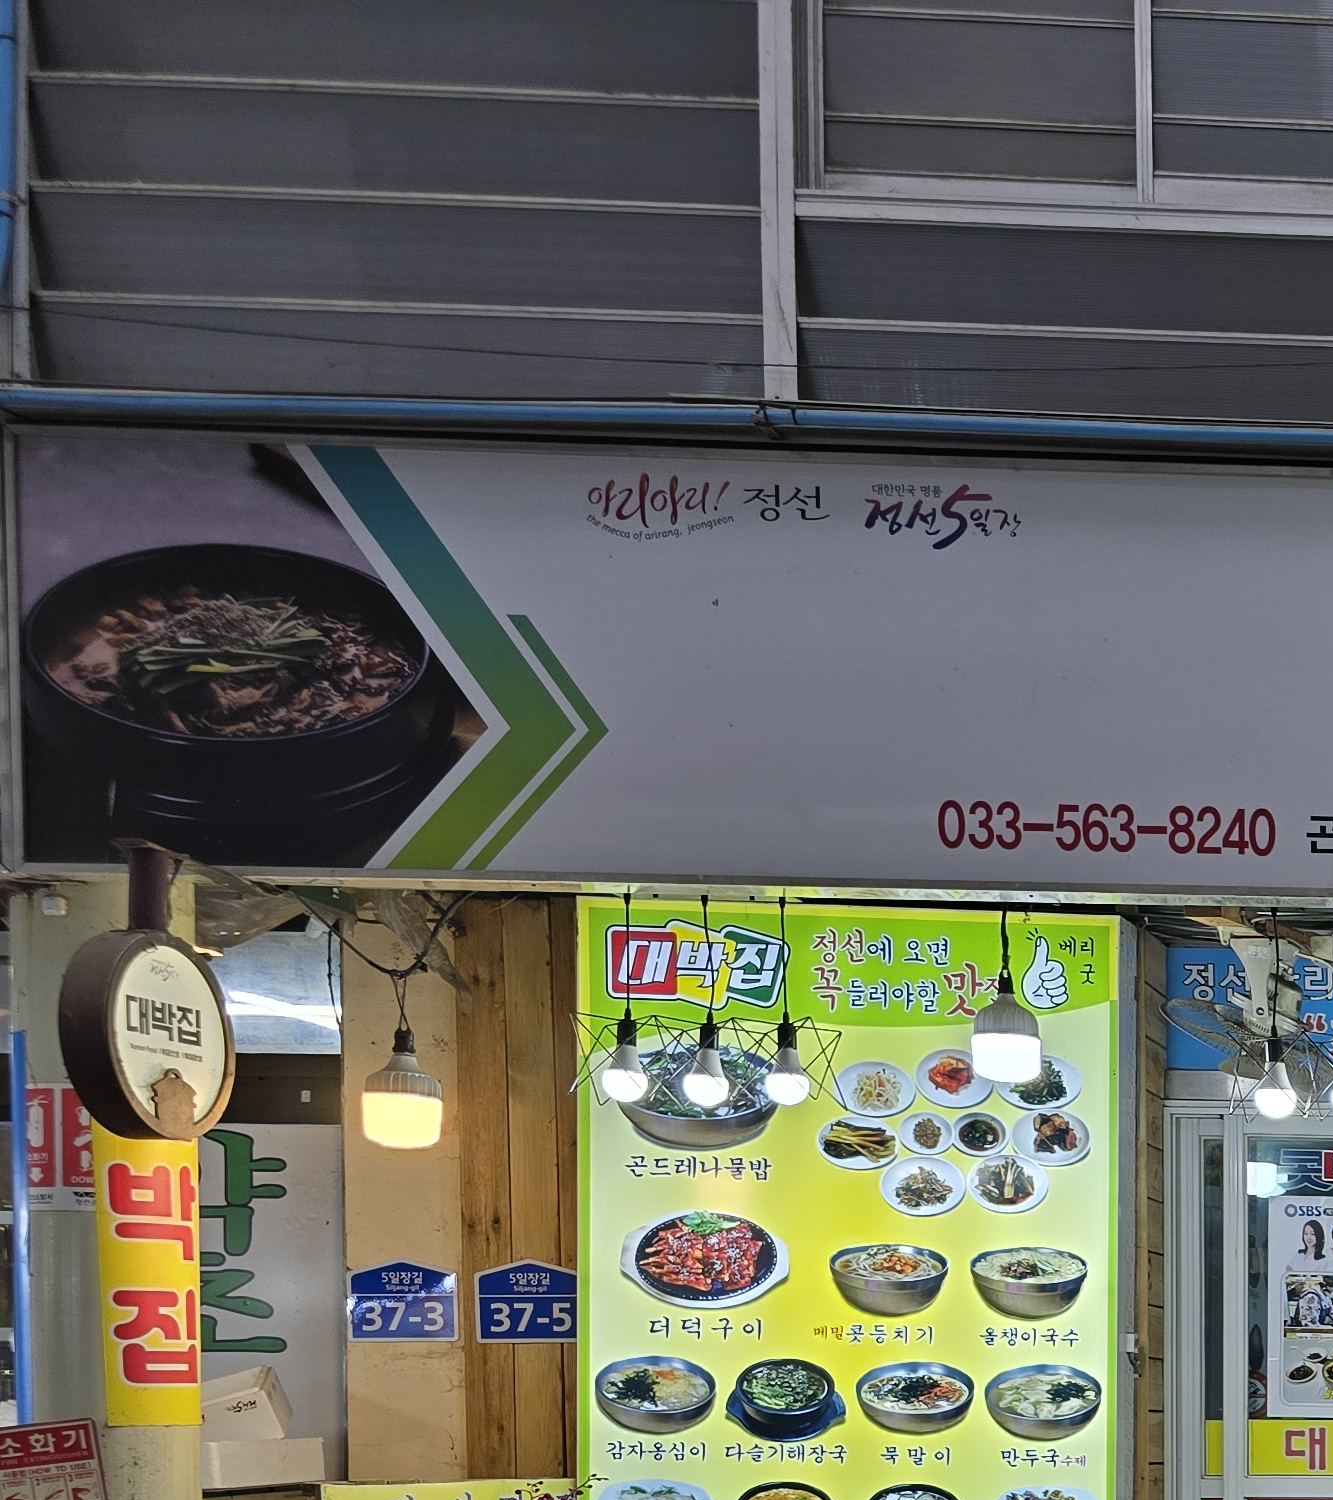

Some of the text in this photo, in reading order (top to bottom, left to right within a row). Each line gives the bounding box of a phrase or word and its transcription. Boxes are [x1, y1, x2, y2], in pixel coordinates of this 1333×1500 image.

[742, 484, 831, 523] 정선
[871, 484, 943, 498] 대한민국 명품
[585, 513, 601, 528] the
[601, 523, 631, 540] mecca
[633, 529, 644, 542] of
[687, 514, 735, 537] jeongseon
[937, 799, 1276, 857] 033-563-8240
[810, 927, 951, 966] 정선에 오면
[1058, 936, 1096, 958] 베리
[616, 934, 782, 991] 대박집
[125, 994, 203, 1048] 대박집
[624, 1155, 773, 1182] 곤드레나물밥
[1298, 1205, 1322, 1217] SBS
[108, 1162, 199, 1386] 박집
[381, 1271, 423, 1285] 5일장길
[509, 1272, 550, 1286] 5일장길
[361, 1301, 445, 1332] 37-3
[490, 1302, 572, 1332] 37-5
[648, 1316, 764, 1342] 더덕구이
[979, 1326, 1081, 1349] 올챙이국수
[0, 1429, 88, 1459] 소화기
[605, 1440, 708, 1463] 감자옹심이
[724, 1442, 848, 1465] 다슬기해장국
[880, 1445, 952, 1468] 묵말이
[1000, 1449, 1060, 1469] 만두국
